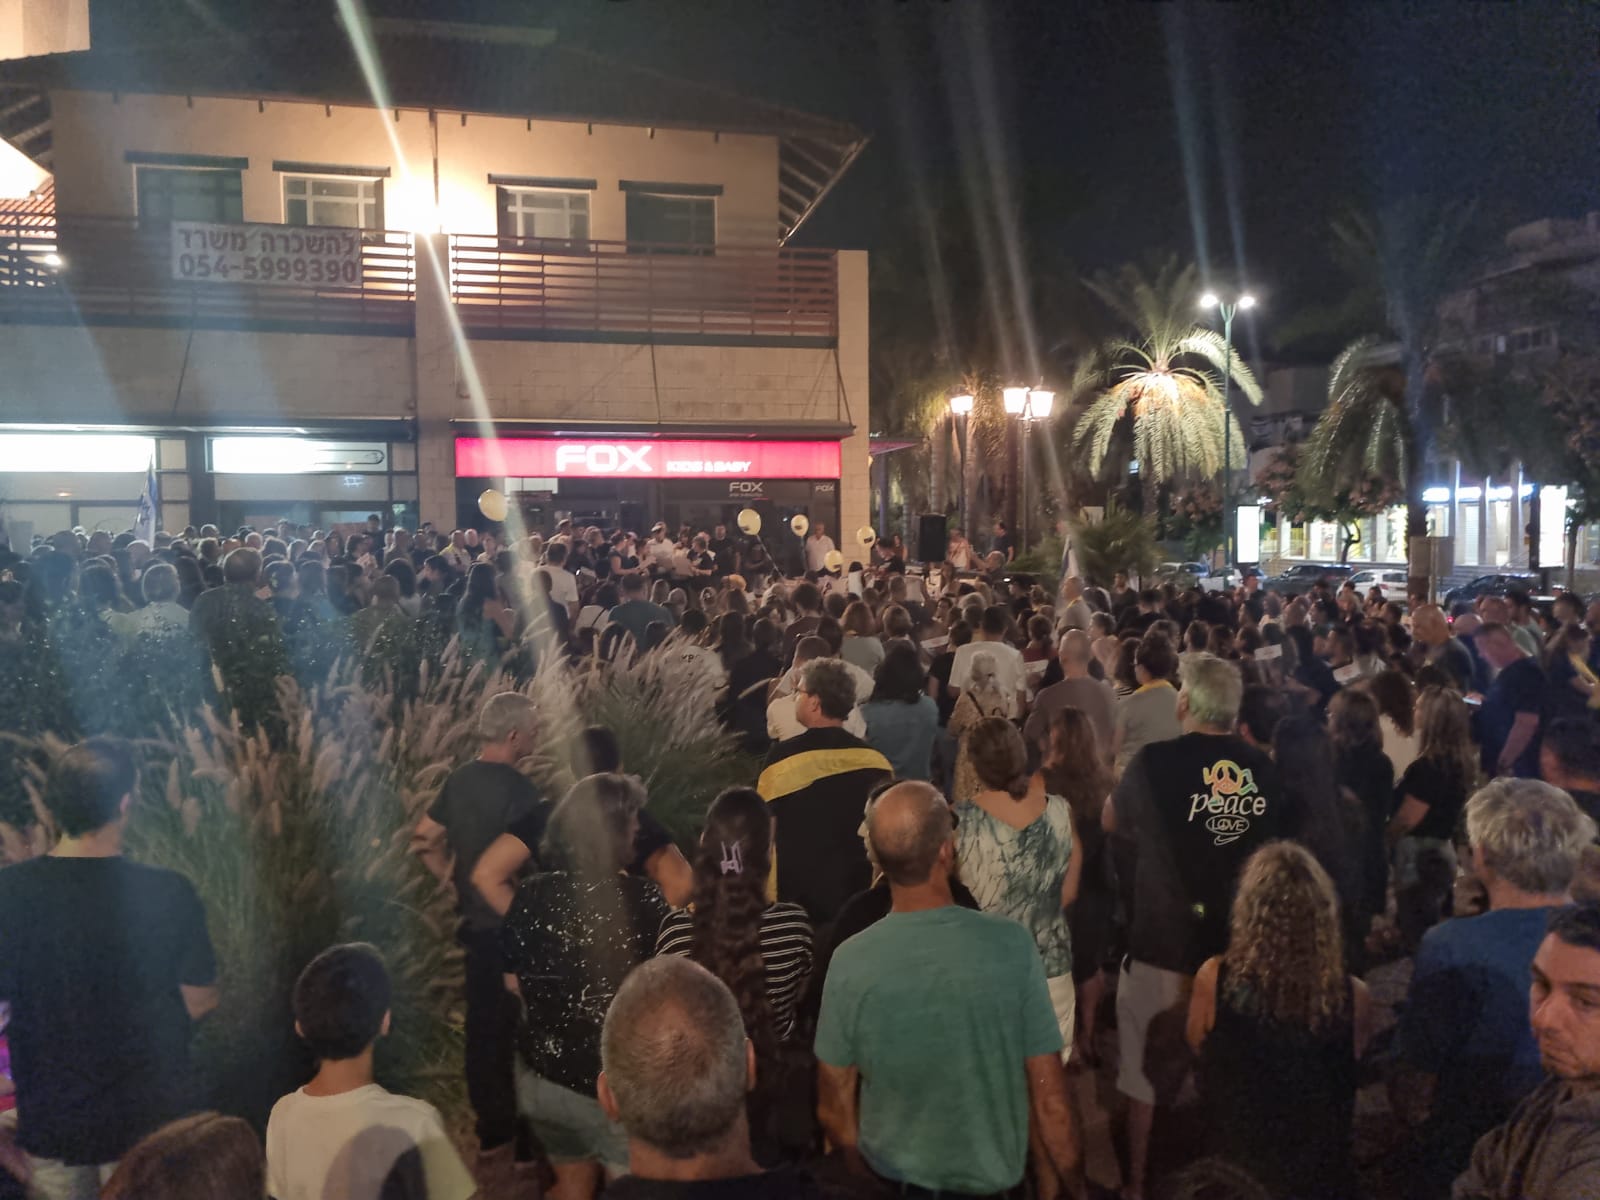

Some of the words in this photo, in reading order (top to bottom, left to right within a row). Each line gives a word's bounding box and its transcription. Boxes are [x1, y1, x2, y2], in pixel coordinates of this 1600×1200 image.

[179, 229, 248, 251] משרד
[261, 232, 355, 255] להשכרה
[179, 254, 357, 282] 054-5999390
[556, 445, 653, 472] FOX
[729, 482, 763, 492] FOX
[1188, 793, 1266, 821] peace
[1212, 819, 1244, 831] LOVE
